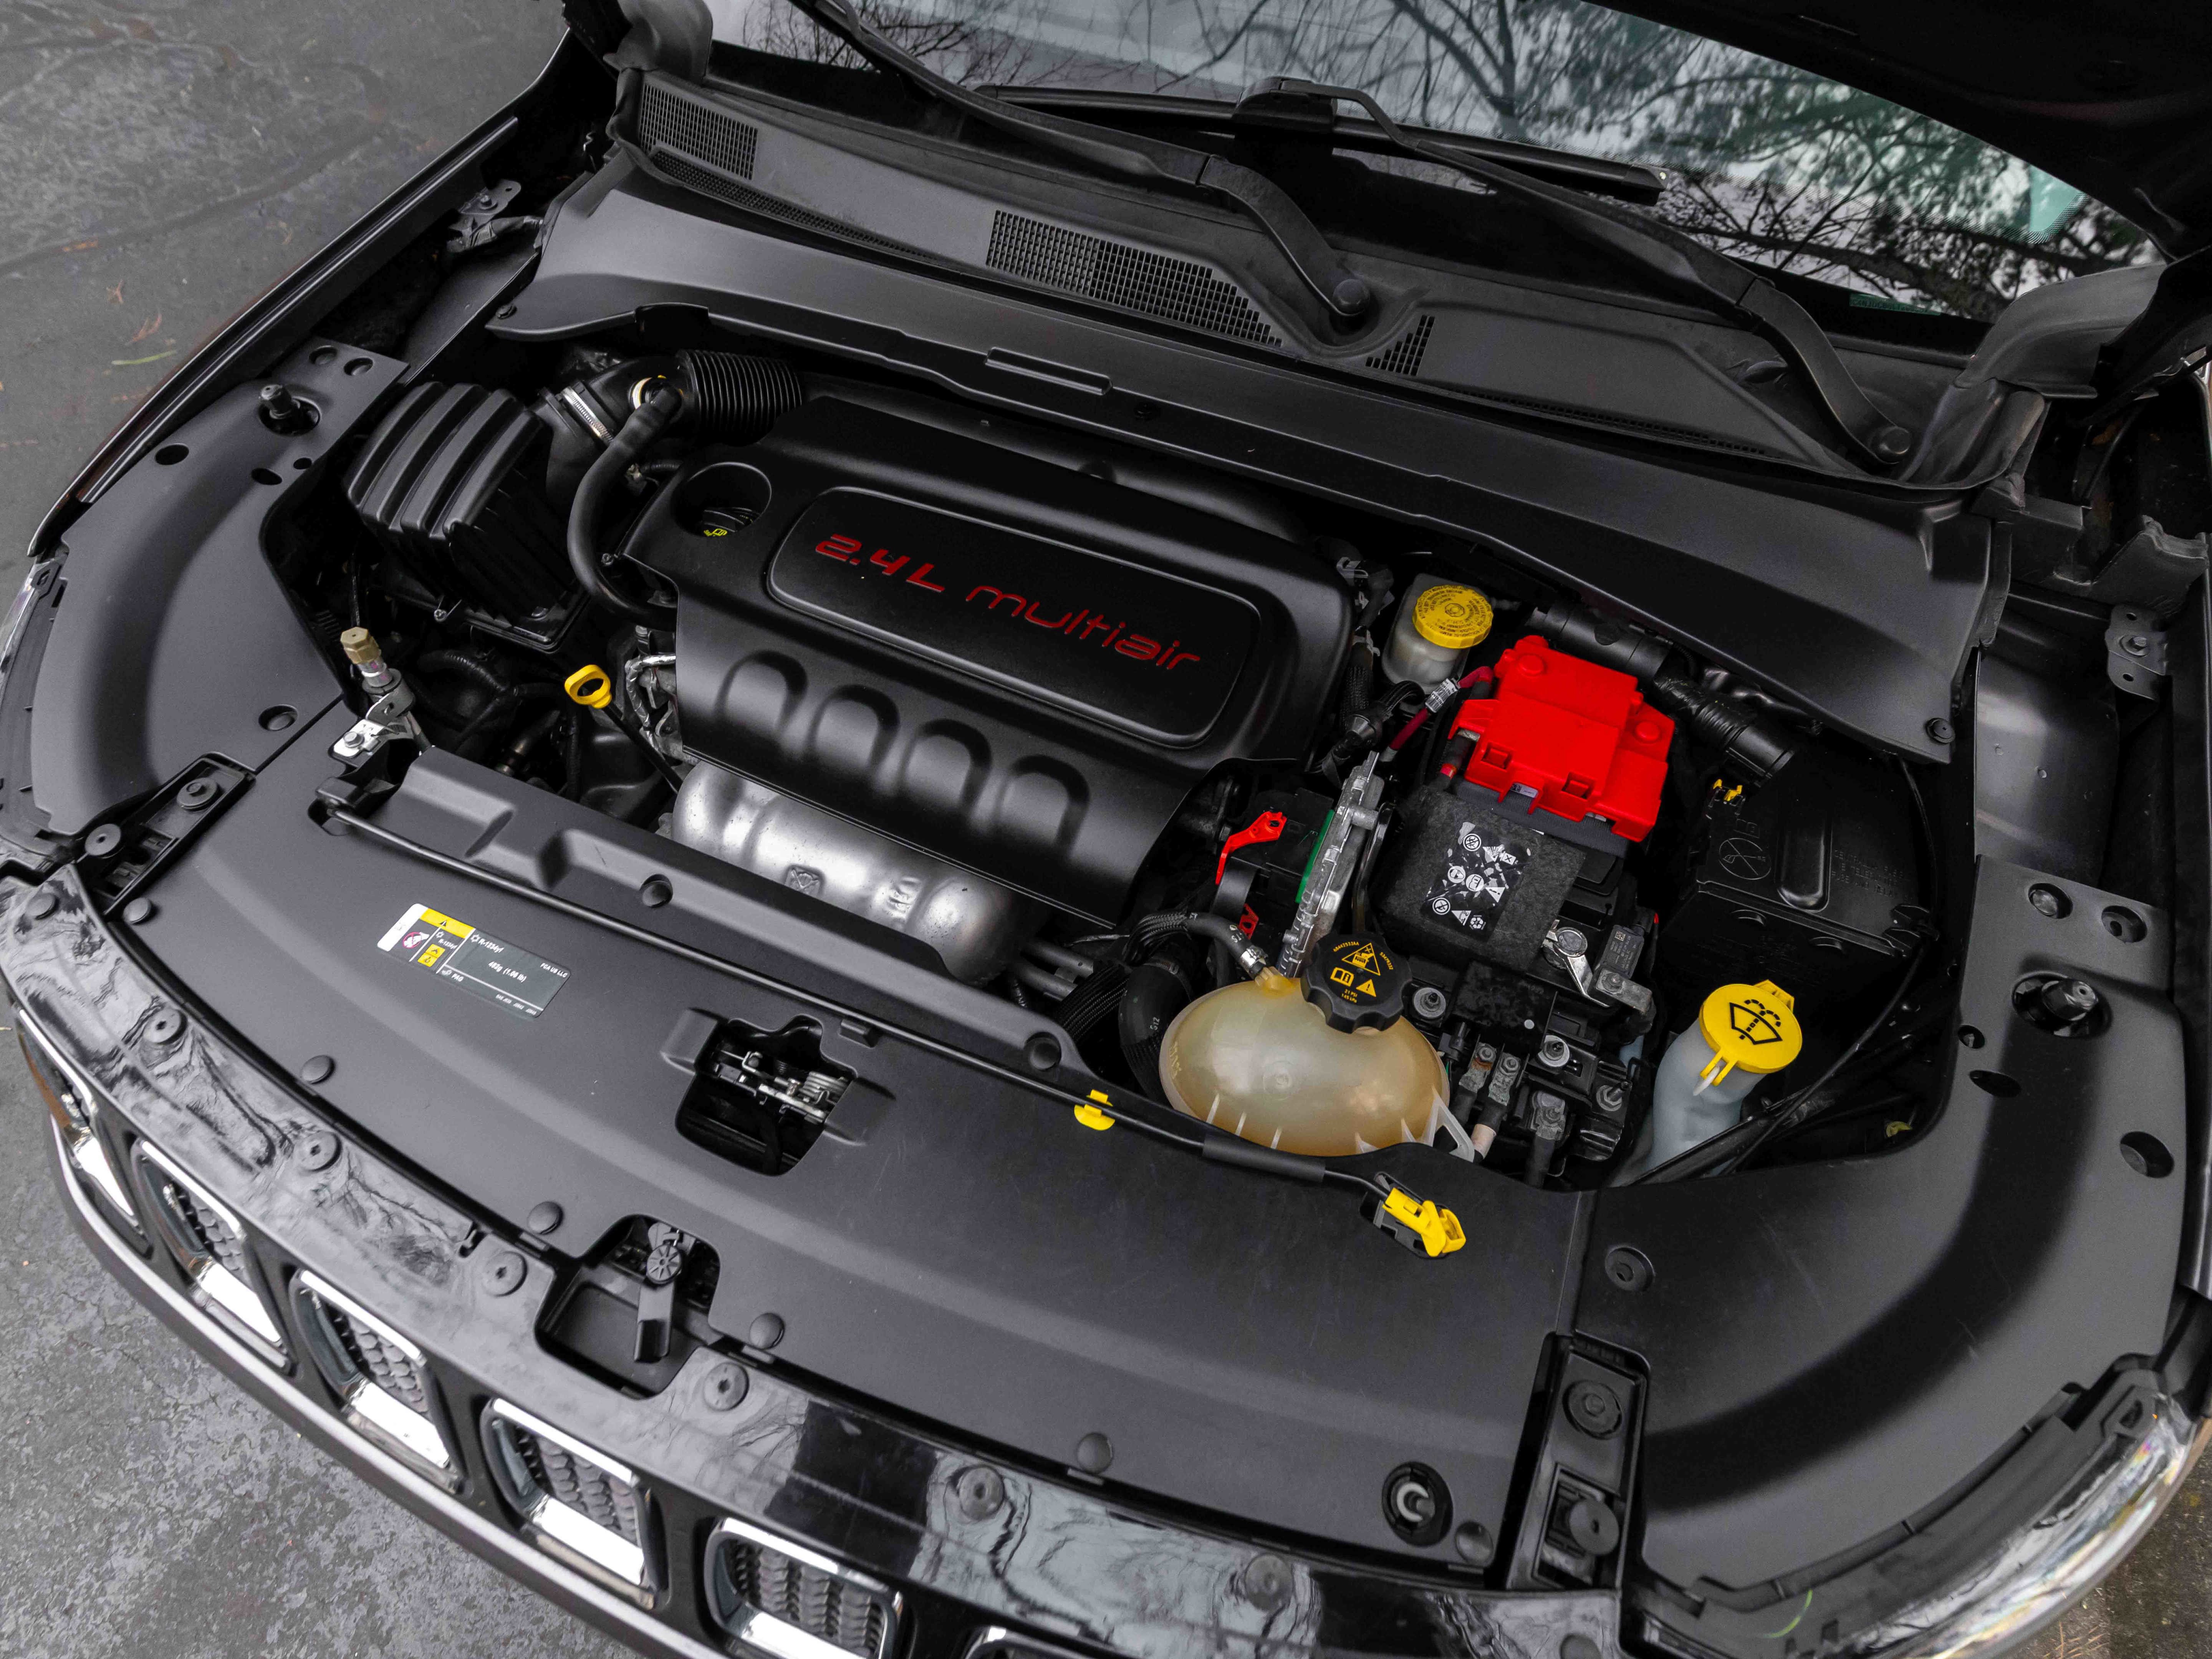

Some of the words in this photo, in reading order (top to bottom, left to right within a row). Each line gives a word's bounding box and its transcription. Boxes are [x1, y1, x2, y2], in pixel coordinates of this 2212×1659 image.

[815, 533, 945, 592] 2.4L
[966, 585, 1200, 670] multiair
[540, 963, 552, 972] FCA
[556, 969, 568, 978] LLC
